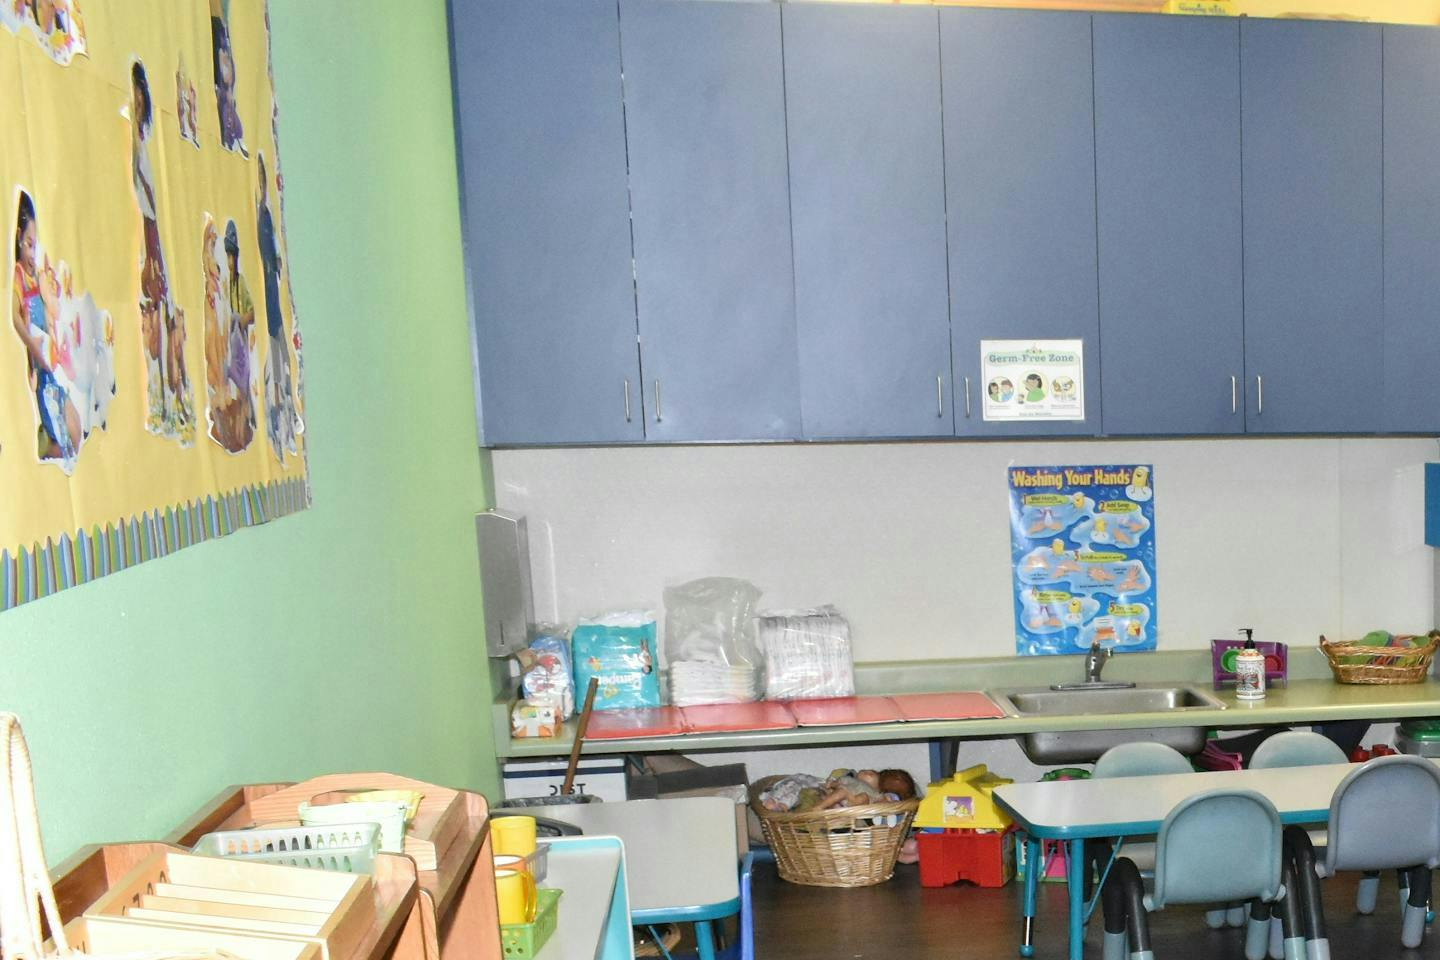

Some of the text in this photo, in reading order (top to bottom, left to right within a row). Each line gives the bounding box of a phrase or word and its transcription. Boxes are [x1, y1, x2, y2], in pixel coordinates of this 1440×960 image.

[988, 353, 1075, 364] Germ-Free Zone
[1012, 469, 1130, 490] Washing Your Hands
